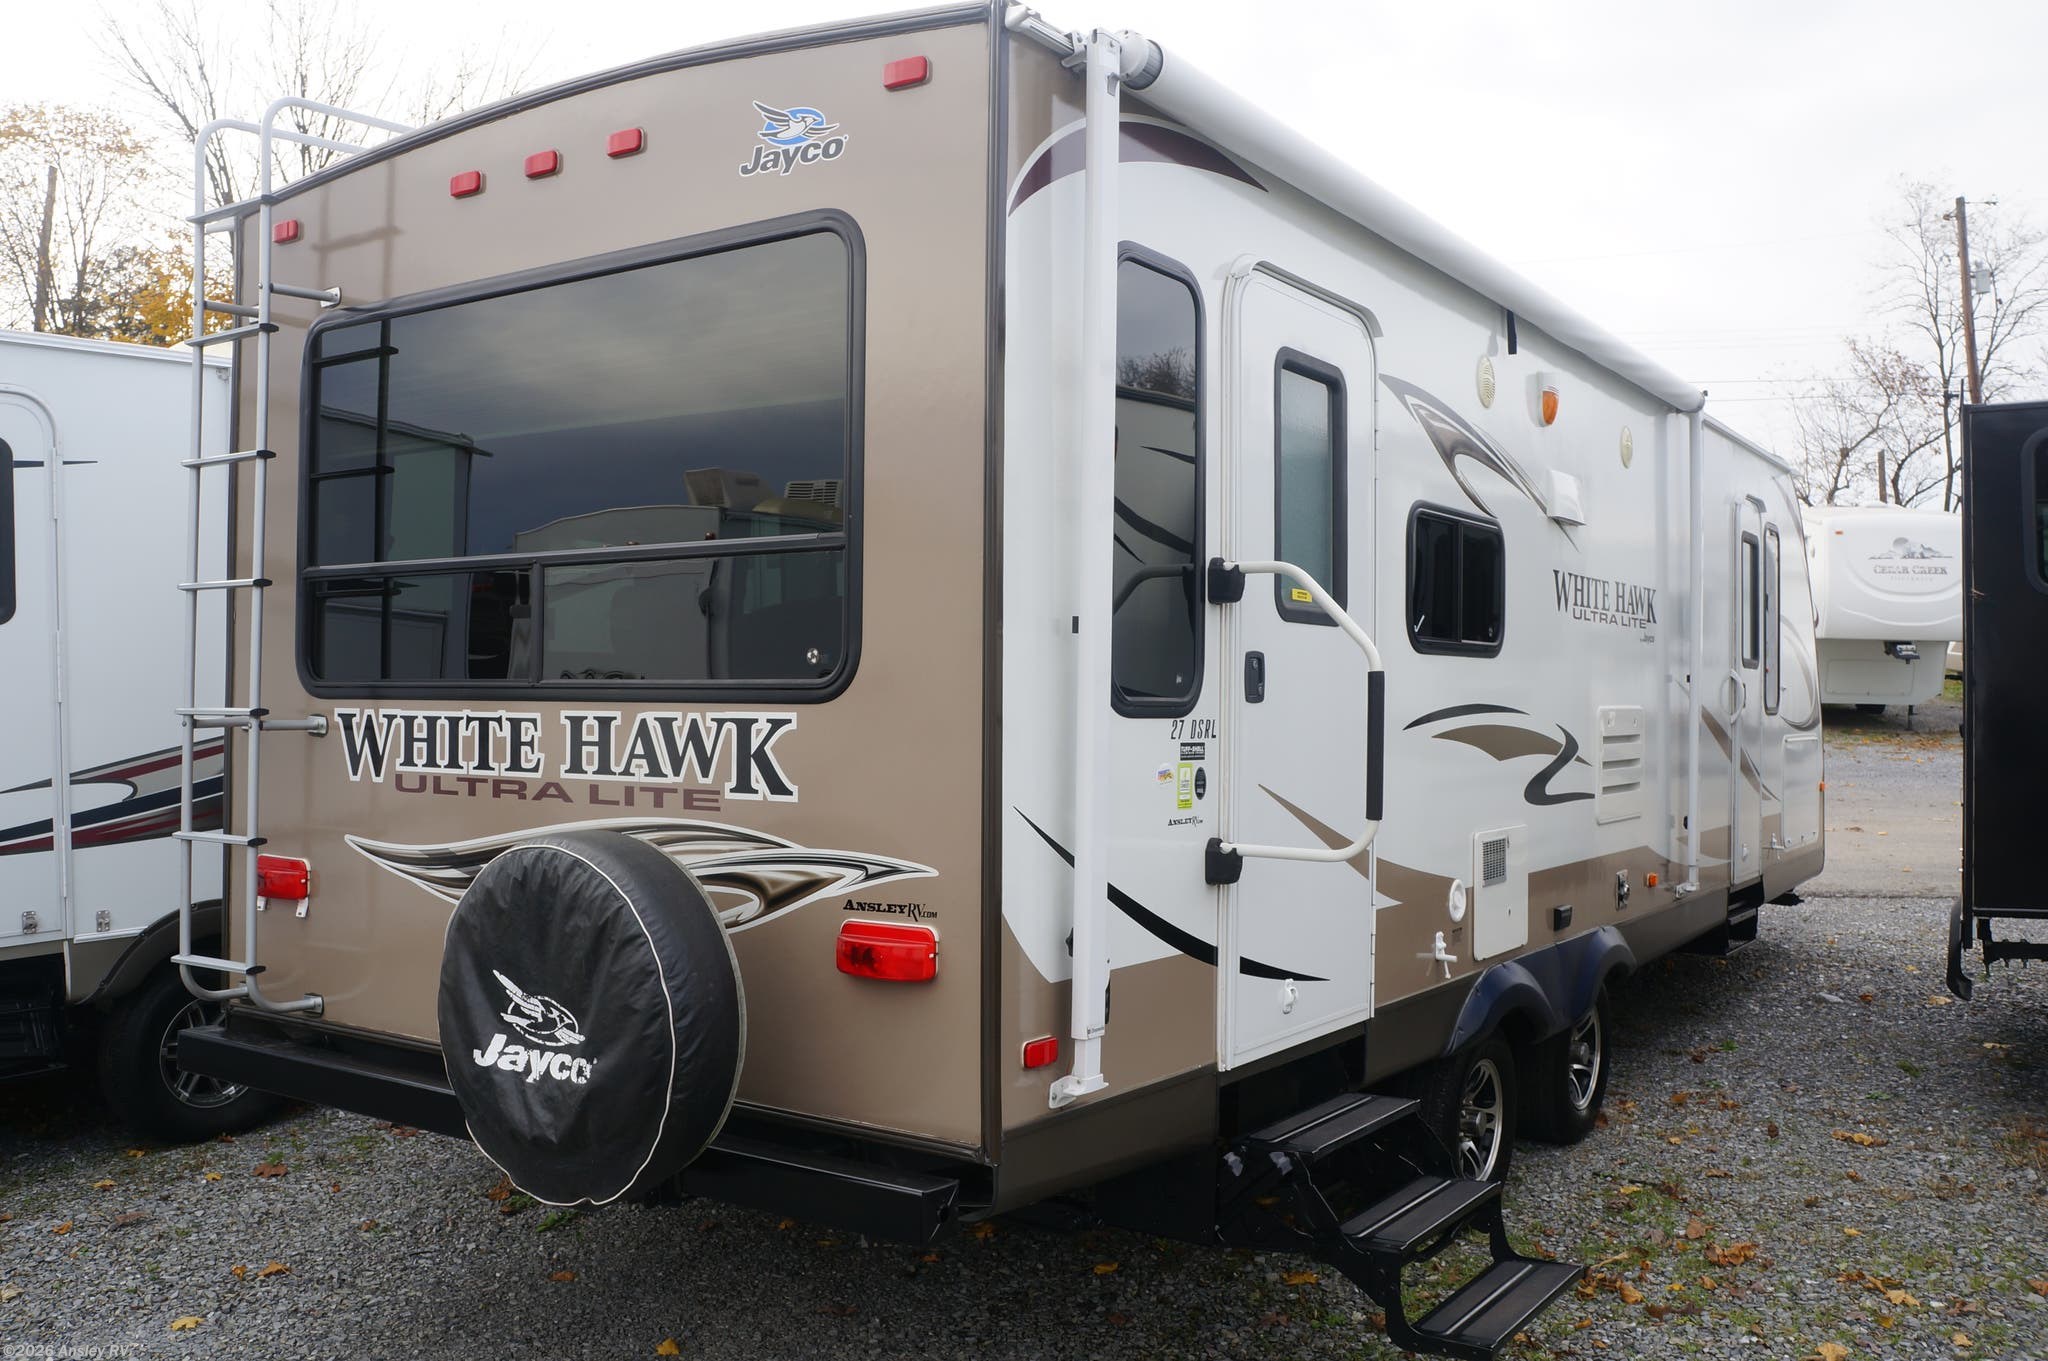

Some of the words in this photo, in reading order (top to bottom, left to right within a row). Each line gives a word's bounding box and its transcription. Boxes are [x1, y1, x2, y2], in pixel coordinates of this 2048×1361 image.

[739, 136, 845, 176] Jayco
[1553, 568, 1611, 613] WHITE
[1615, 580, 1657, 625] HAWK
[1573, 607, 1618, 626] ULTRA
[1621, 615, 1647, 629] LITE
[1170, 719, 1185, 739] 27
[1190, 719, 1217, 739] DSRL
[334, 708, 545, 783] WHITE
[560, 709, 799, 803] HAWK
[394, 773, 574, 804] ULTRA
[589, 784, 721, 812] LITE
[473, 1033, 592, 1085] Jayco
